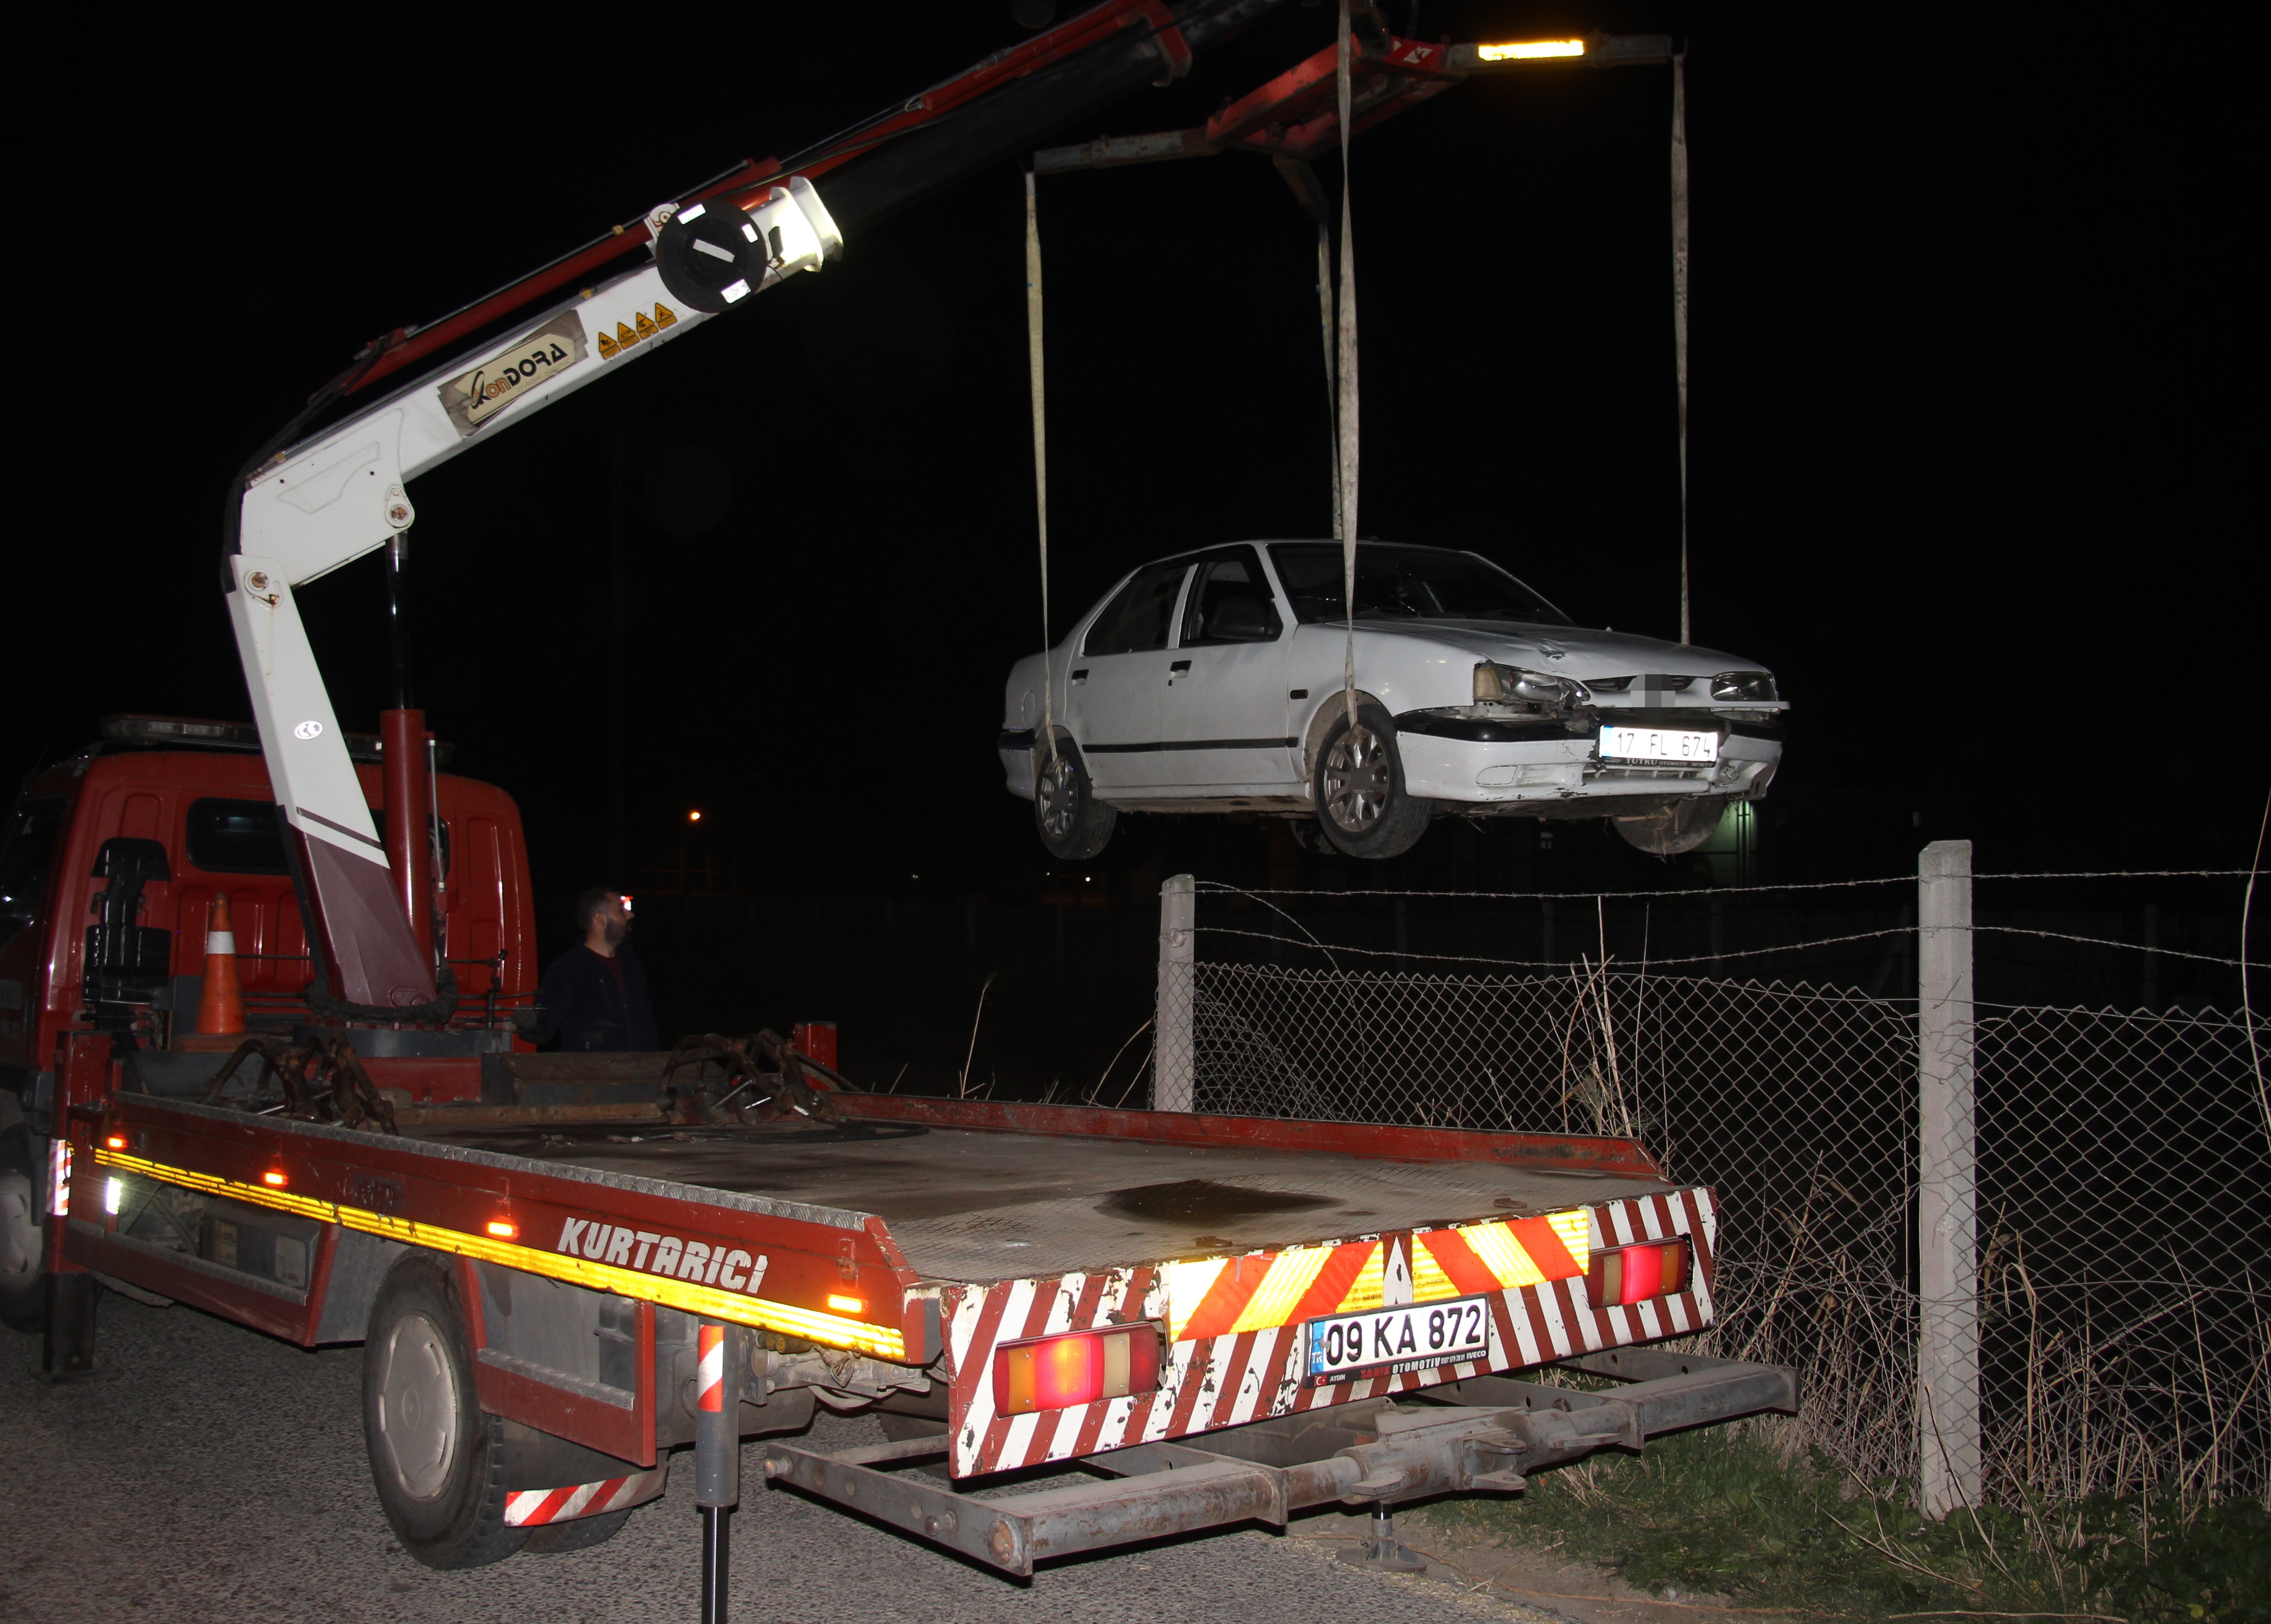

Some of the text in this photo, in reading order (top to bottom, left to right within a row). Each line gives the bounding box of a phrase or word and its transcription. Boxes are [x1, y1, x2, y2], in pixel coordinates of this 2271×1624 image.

[1618, 733, 1710, 758] 17 FL 674
[557, 1217, 768, 1295] KURTARICI
[1312, 1305, 1481, 1366] TR 09 KA 872
[1466, 1350, 1486, 1359] IVECO
